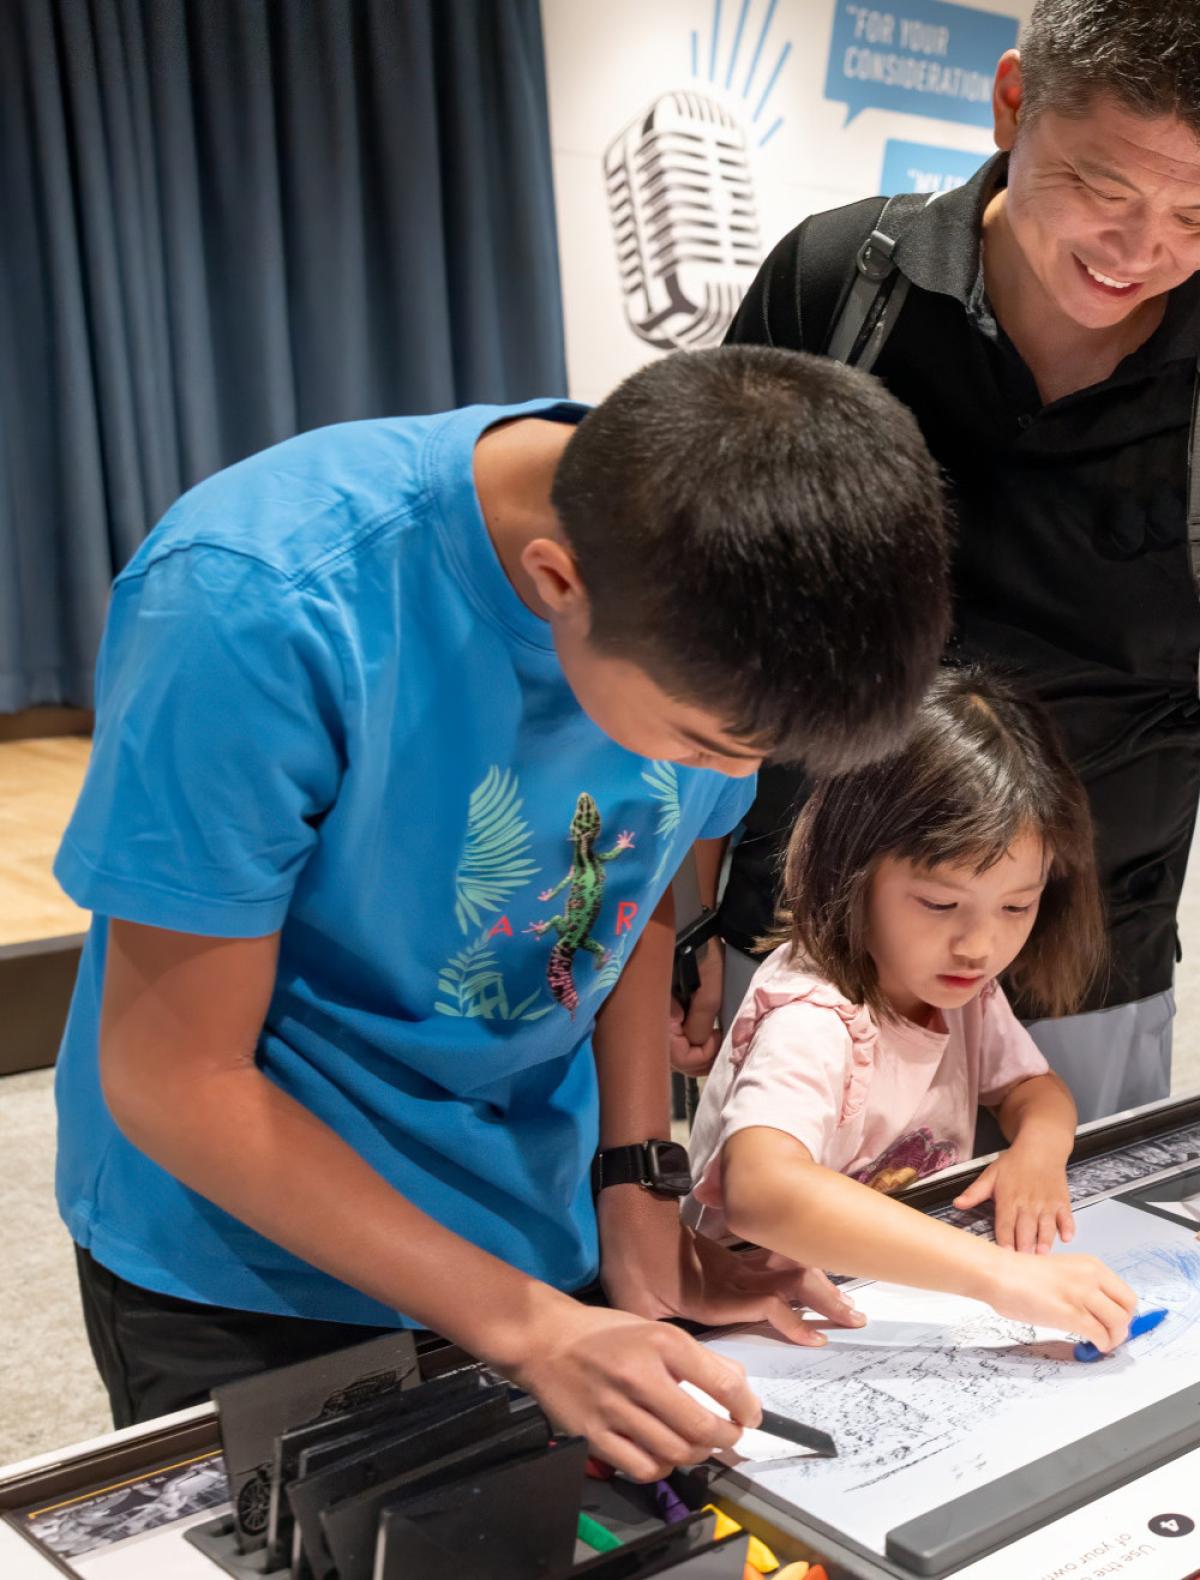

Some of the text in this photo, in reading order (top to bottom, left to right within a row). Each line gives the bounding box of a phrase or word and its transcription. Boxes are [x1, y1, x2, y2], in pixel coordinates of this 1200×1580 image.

[901, 18, 950, 57] YOUR
[1080, 1542, 1116, 1564] your
[1115, 1533, 1131, 1546] of
[1093, 1544, 1157, 1577] Use the
